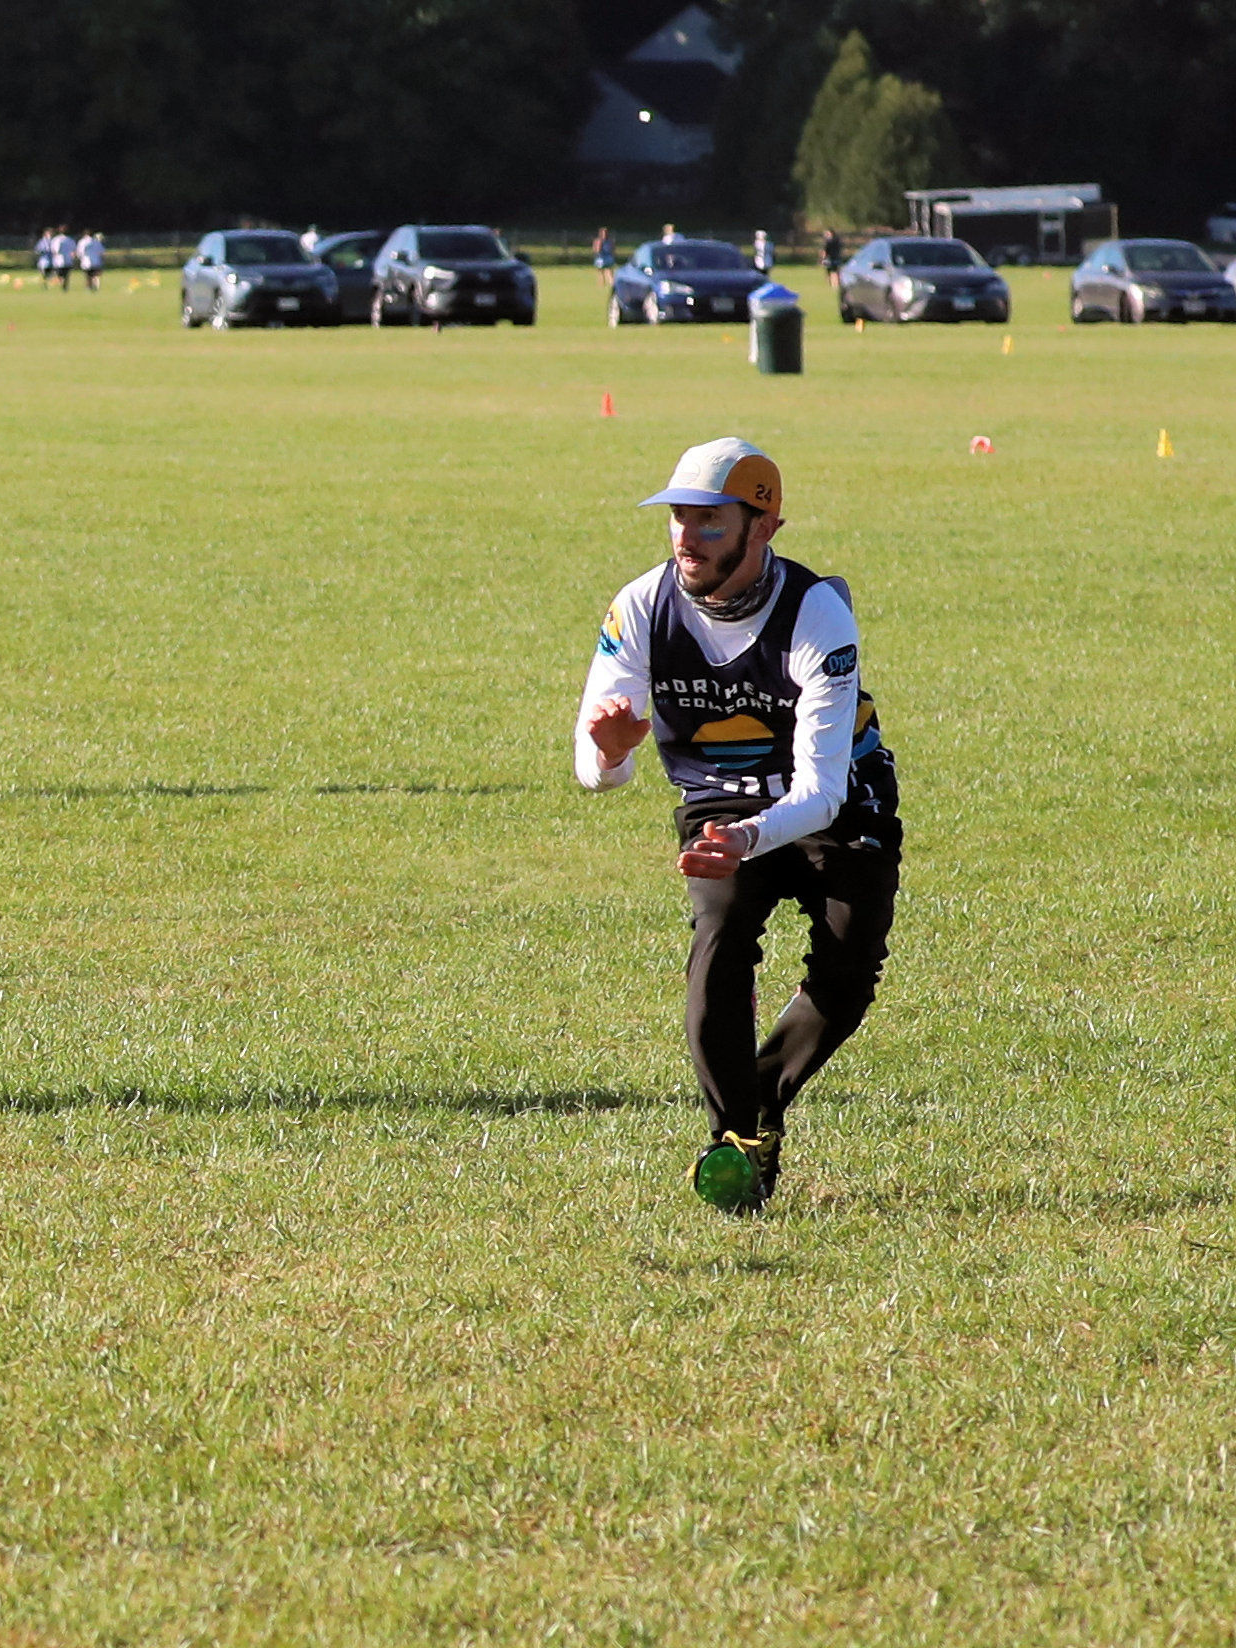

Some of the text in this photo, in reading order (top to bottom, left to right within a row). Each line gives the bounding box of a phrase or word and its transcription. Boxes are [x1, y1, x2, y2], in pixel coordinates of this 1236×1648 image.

[755, 484, 772, 504] 24
[655, 679, 795, 708] NORTHERN
[678, 696, 774, 715] COMFORT
